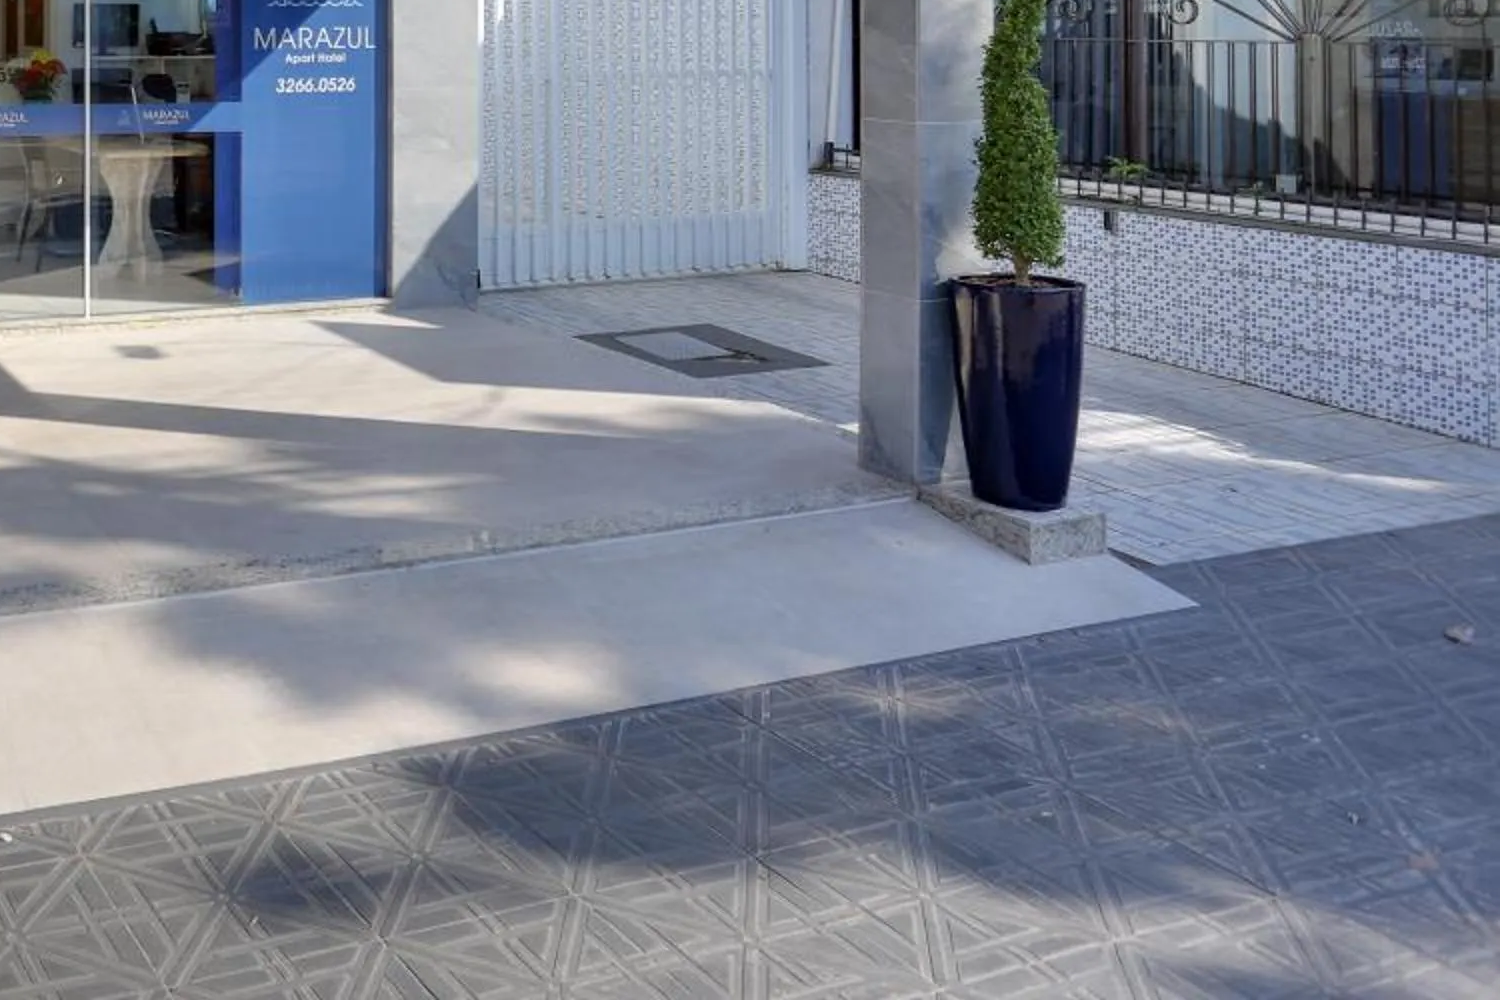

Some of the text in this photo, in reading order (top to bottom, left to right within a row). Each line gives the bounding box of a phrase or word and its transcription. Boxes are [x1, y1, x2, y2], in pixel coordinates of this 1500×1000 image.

[253, 26, 377, 50] MARAZUL
[285, 52, 348, 65] Apart Hotel
[275, 76, 356, 94] 3266.0526
